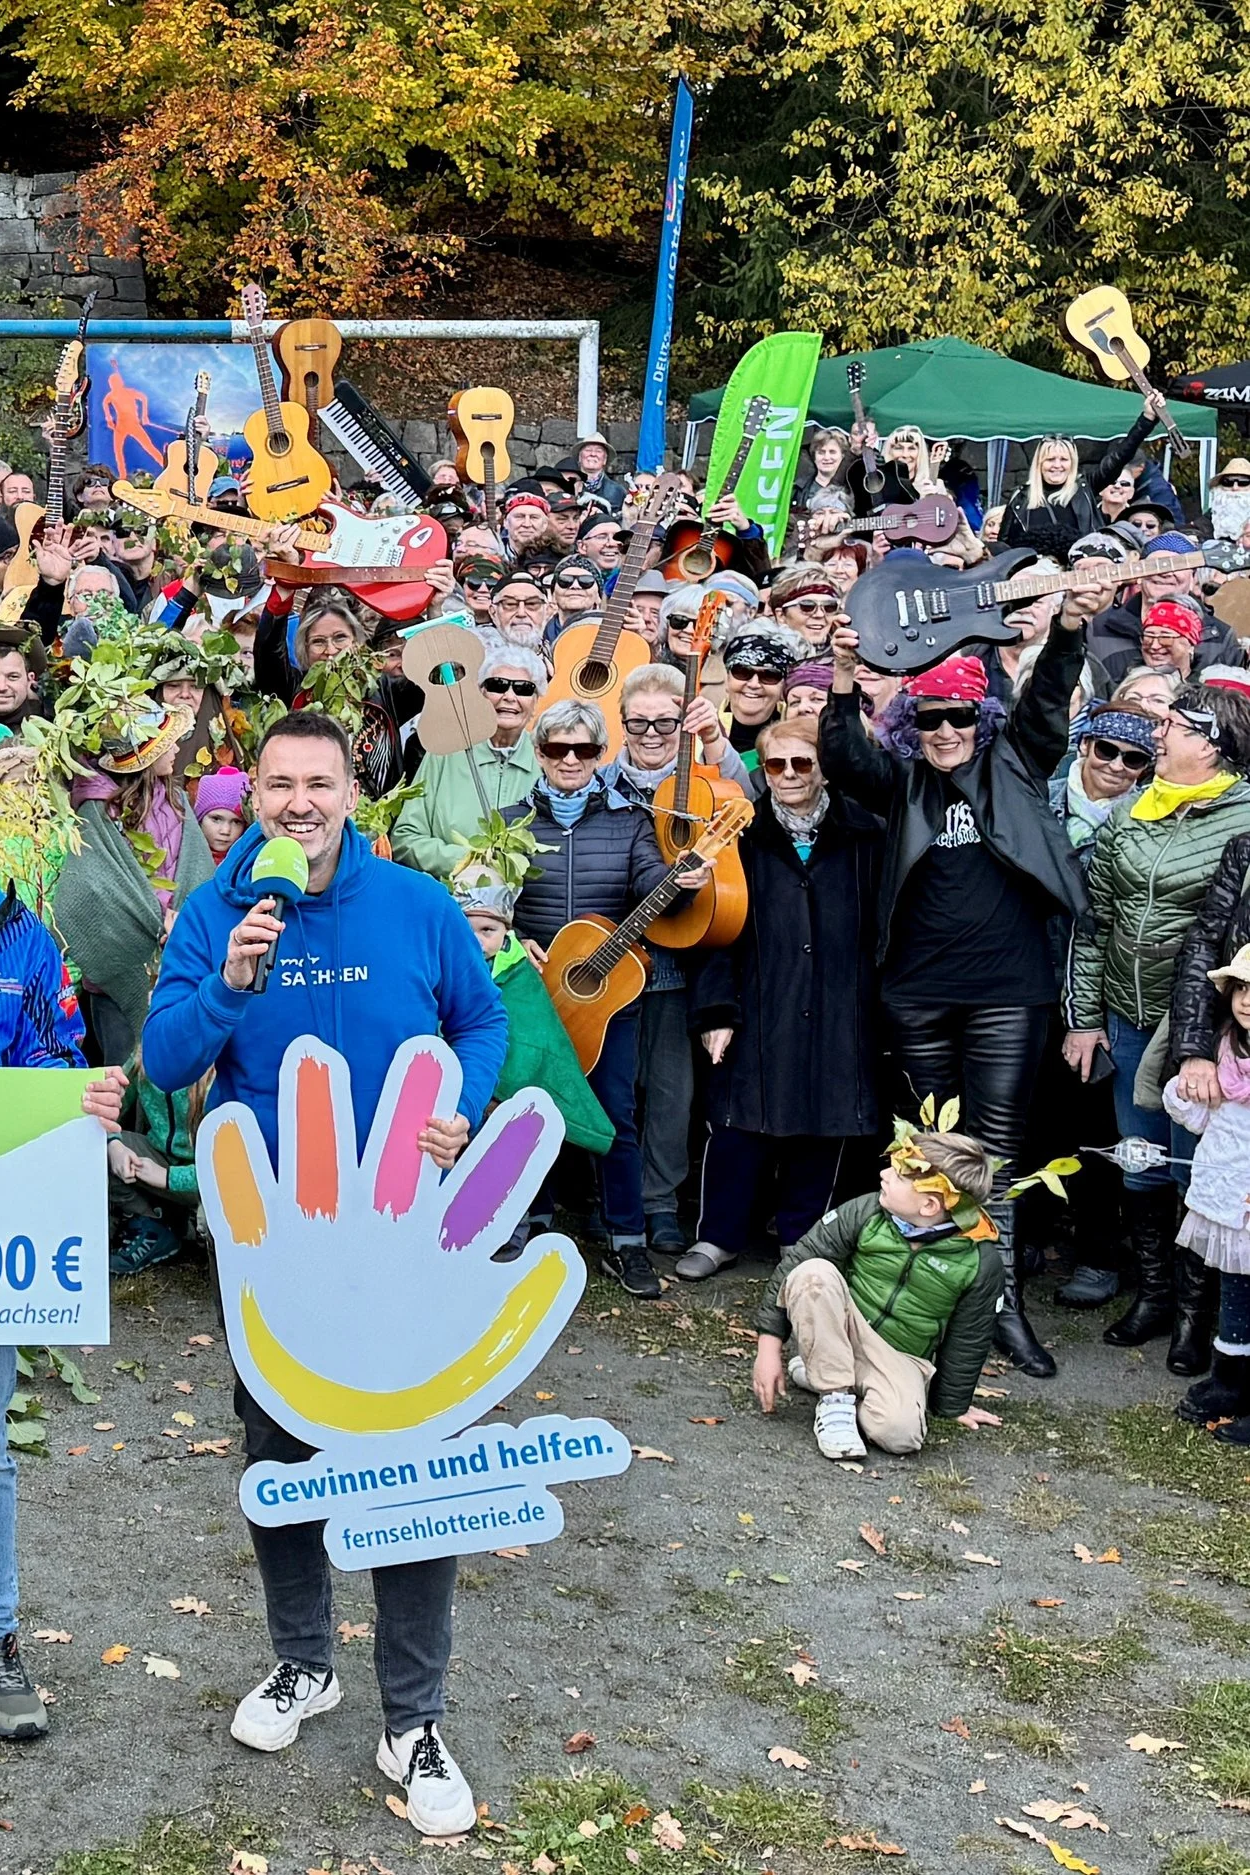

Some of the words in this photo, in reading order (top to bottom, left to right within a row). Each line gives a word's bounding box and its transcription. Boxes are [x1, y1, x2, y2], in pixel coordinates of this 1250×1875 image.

[51, 1236, 83, 1292] €
[256, 1463, 419, 1507] Gewinnen
[429, 1443, 489, 1481] und
[497, 1430, 615, 1470] helfen.
[342, 1500, 546, 1551] fernsehlotterie.de
